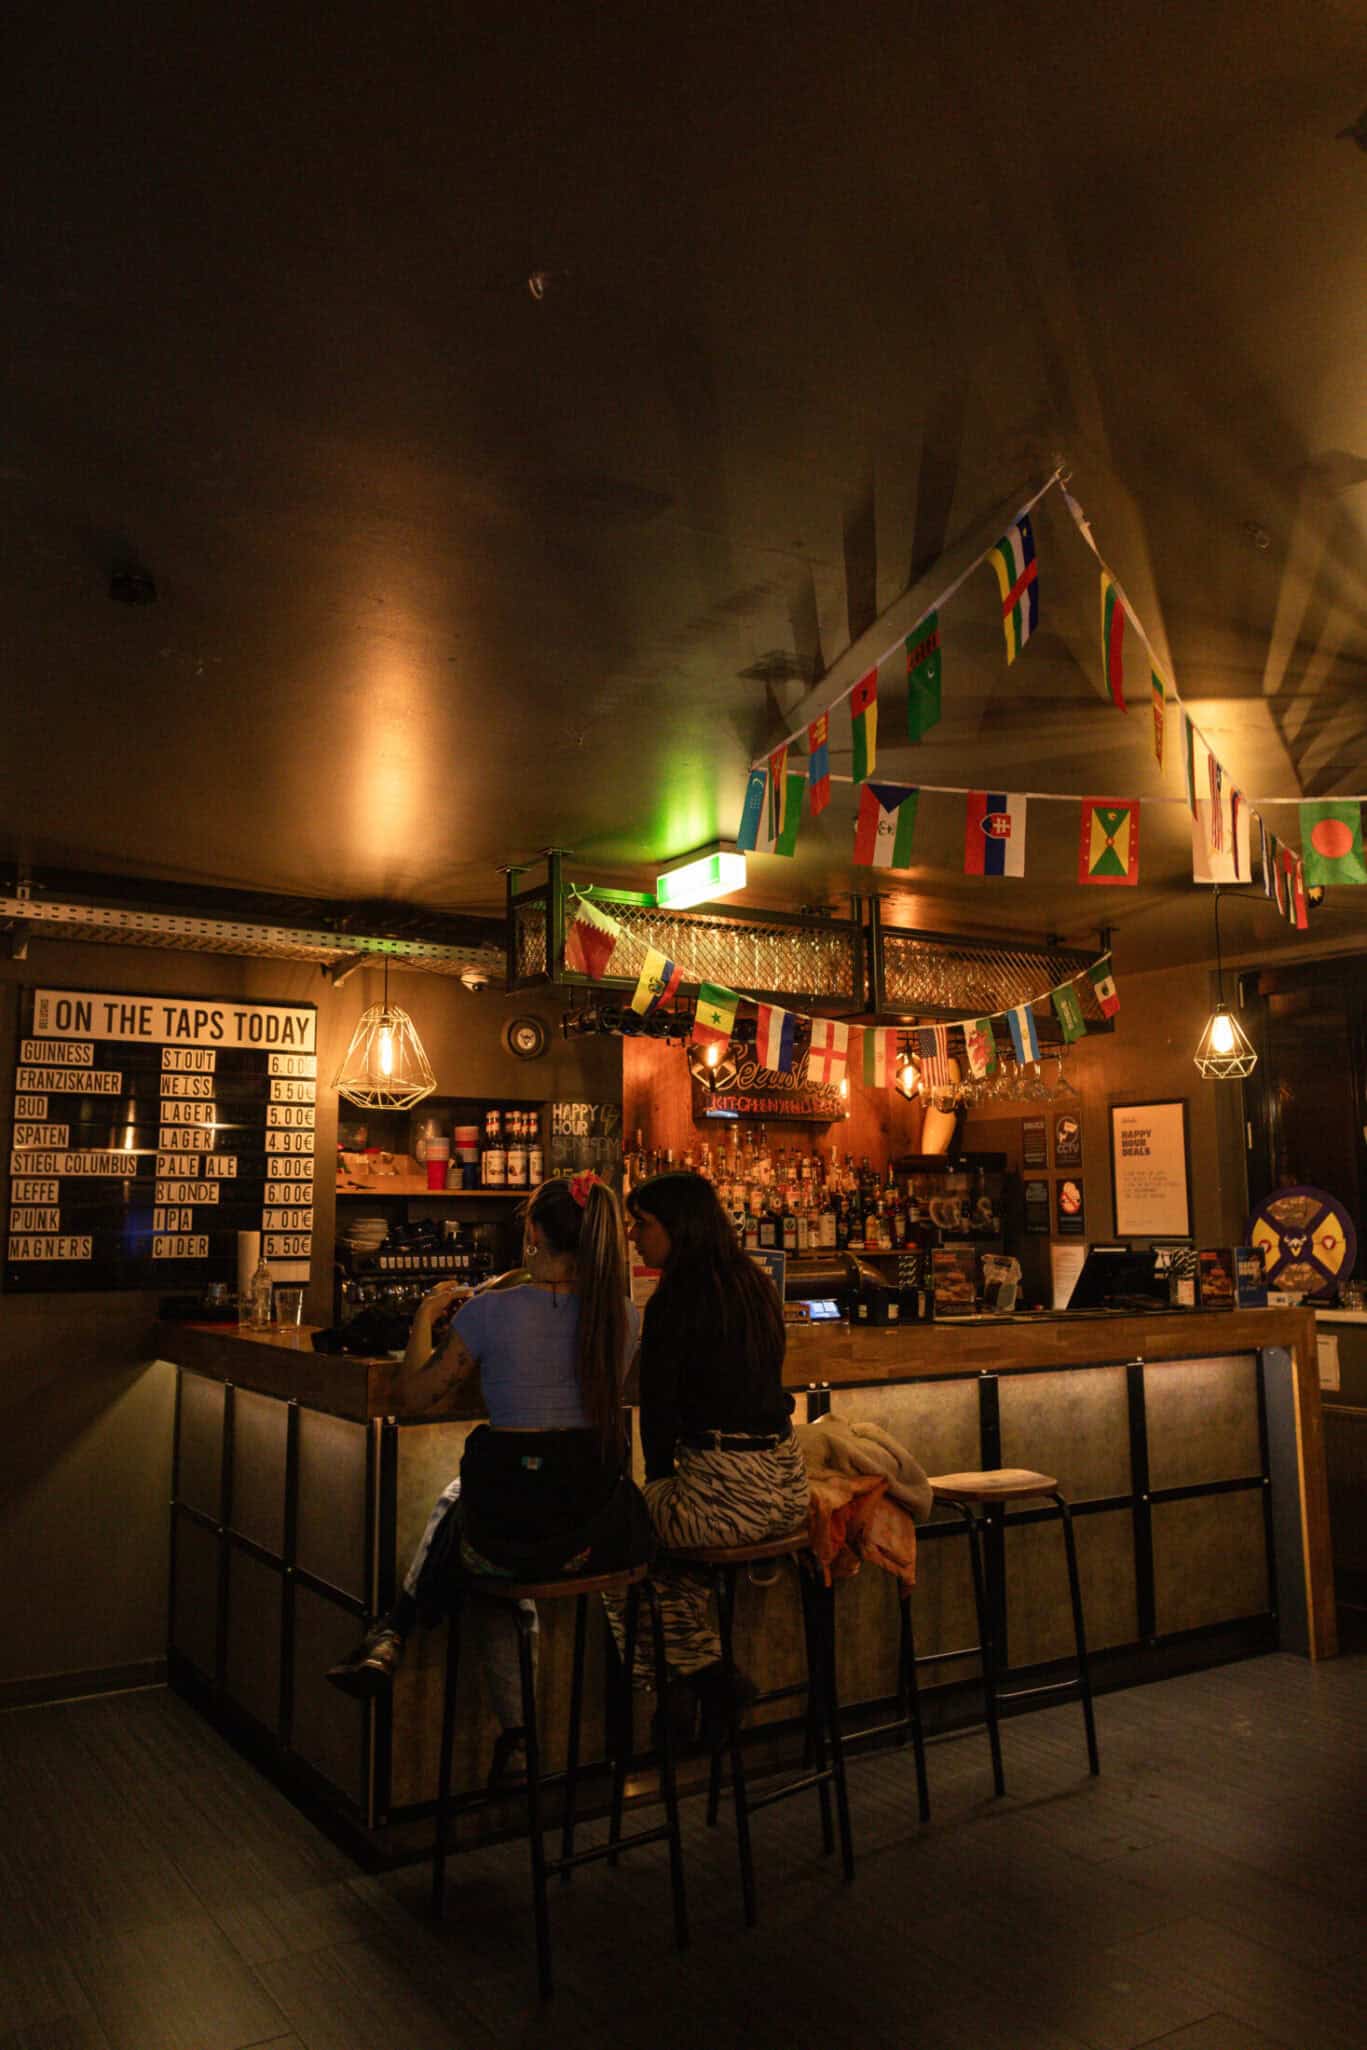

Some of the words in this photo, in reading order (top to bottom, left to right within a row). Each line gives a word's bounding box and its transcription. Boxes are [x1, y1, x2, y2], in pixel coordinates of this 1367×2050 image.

[56, 1000, 92, 1031] ON
[104, 1003, 152, 1036] THE
[163, 1007, 224, 1040] TAPS
[234, 1012, 309, 1045] TODAY
[24, 1042, 91, 1063] GUINNESS
[163, 1050, 214, 1070] STOUT
[20, 1070, 120, 1092] FRANZISKANER
[161, 1077, 210, 1096] WEISS
[18, 1098, 45, 1117] BUD
[162, 1104, 212, 1122] LAGER
[270, 1105, 312, 1125] 5.00€
[552, 1104, 600, 1120] HAPPY
[16, 1126, 66, 1145] SPATEN
[552, 1120, 588, 1136] HOUR
[1121, 1129, 1152, 1138] HAPPY
[161, 1130, 212, 1149] LAGER
[269, 1132, 312, 1151] 4.90€
[1057, 1142, 1080, 1154] CCTV
[14, 1154, 60, 1173] STIEGL
[65, 1155, 136, 1175] COLUMBUS
[158, 1157, 196, 1175] PALE
[207, 1157, 235, 1175] ALE
[271, 1158, 312, 1177] 6.00€
[15, 1182, 55, 1201] LEFFE
[157, 1184, 217, 1201] BLONDE
[268, 1184, 312, 1202] 6.00€
[12, 1211, 57, 1229] PUNK
[156, 1211, 190, 1229] IPA
[266, 1210, 311, 1228] 7.00€
[10, 1238, 91, 1257] MAGNERS
[155, 1238, 207, 1255] CIDER
[267, 1236, 310, 1254] 5.50€
